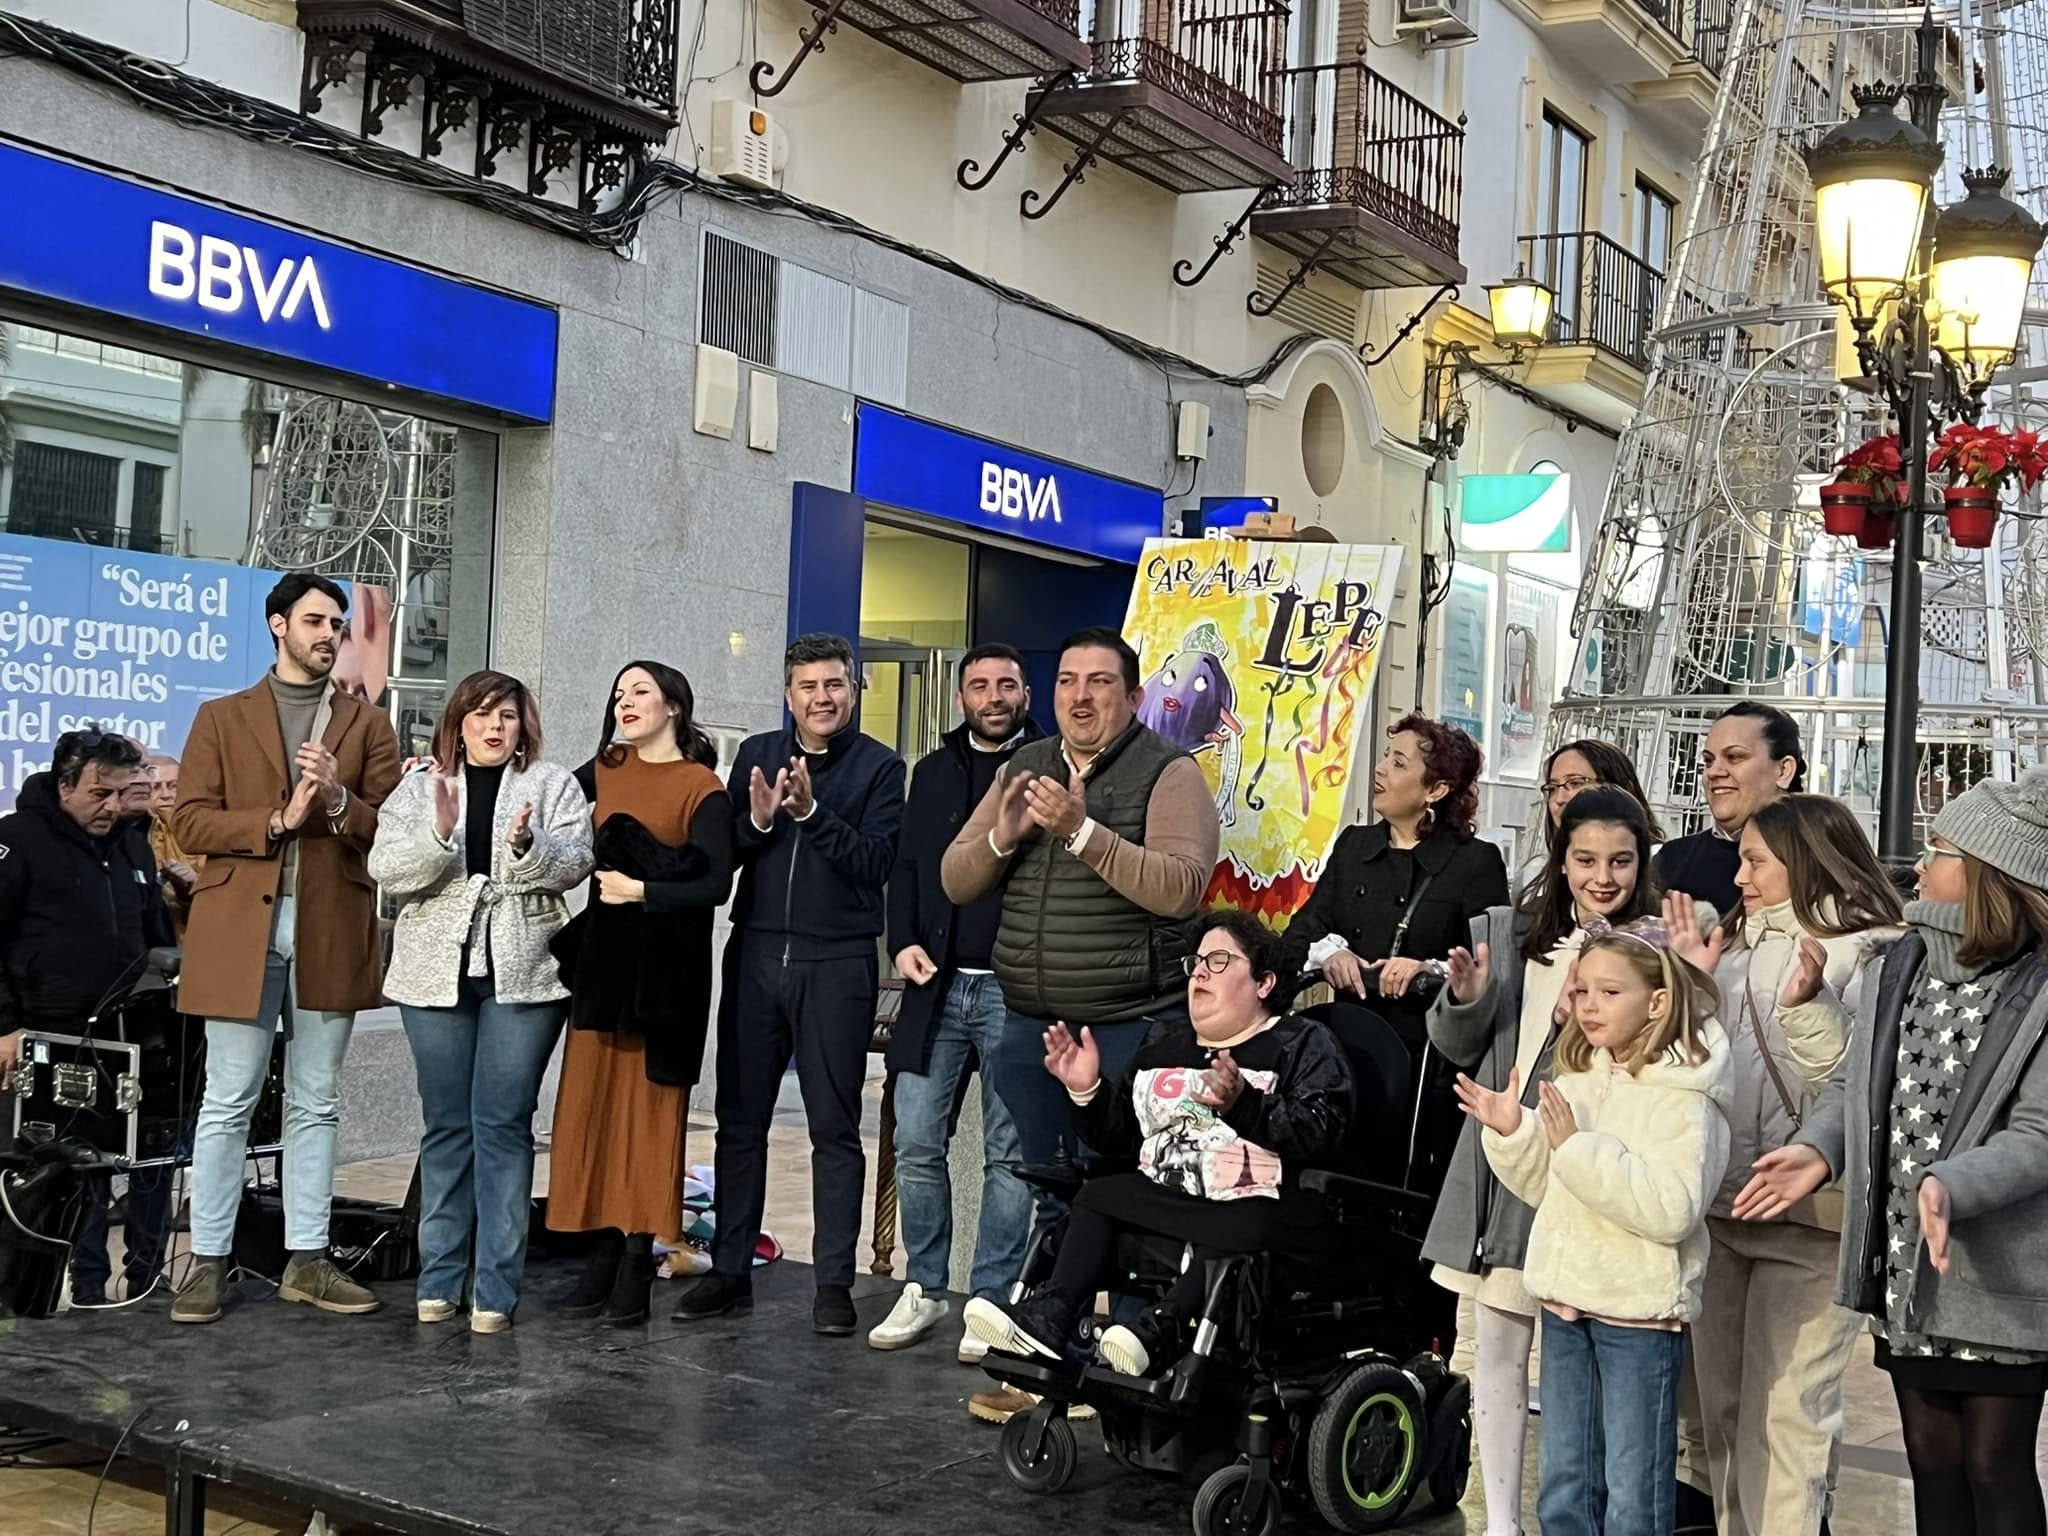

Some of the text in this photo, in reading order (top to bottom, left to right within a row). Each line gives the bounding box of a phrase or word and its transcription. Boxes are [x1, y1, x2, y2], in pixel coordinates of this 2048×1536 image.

[148, 220, 331, 329] BBVA
[979, 462, 1062, 523] BBVA
[200, 577, 228, 617] el
[73, 618, 181, 665] grupo
[187, 621, 228, 662] de
[1252, 581, 1385, 676] LEPE
[0, 699, 51, 743] del
